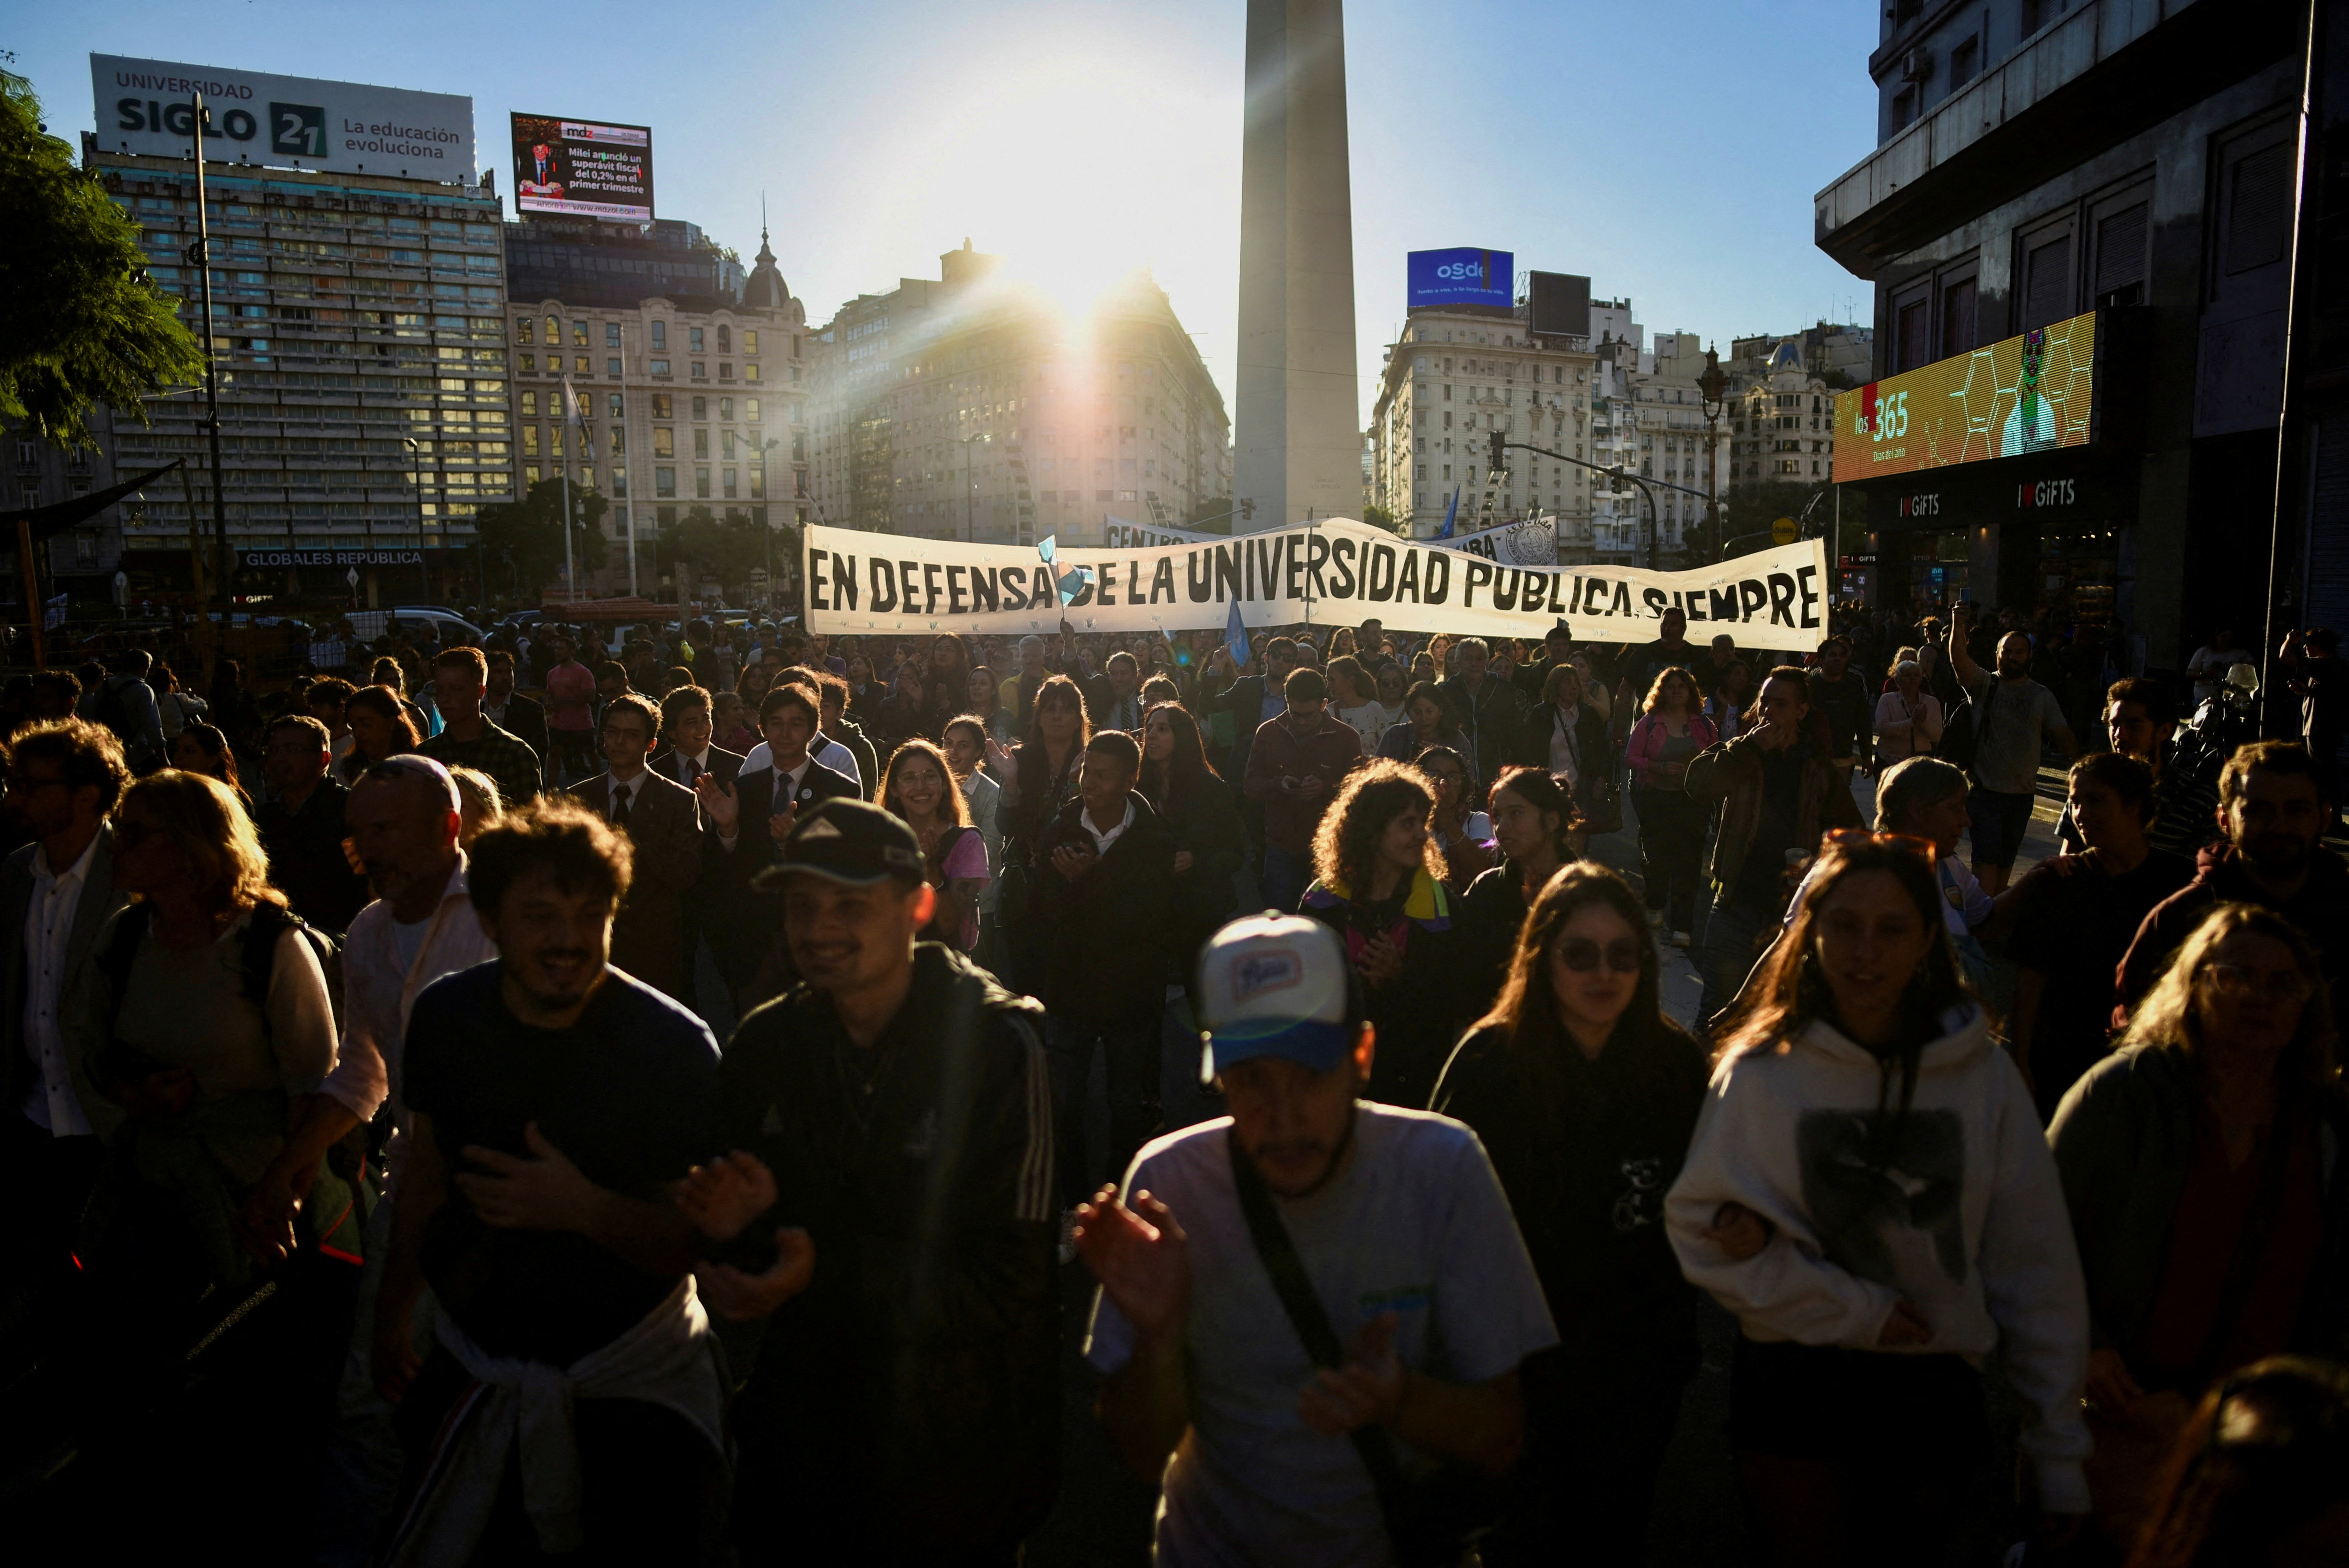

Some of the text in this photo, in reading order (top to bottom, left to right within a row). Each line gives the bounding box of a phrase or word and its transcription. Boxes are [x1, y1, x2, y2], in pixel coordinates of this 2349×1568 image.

[116, 72, 253, 100] UNIVERSIDAD
[117, 98, 319, 155] SIGLO 21
[344, 118, 460, 144] La educación
[567, 126, 593, 138] mdz
[345, 137, 444, 159] evoluciona
[569, 147, 591, 158] Milei
[592, 150, 628, 162] anunció
[572, 159, 640, 173] superávit fiscal
[576, 169, 590, 178] del
[591, 172, 614, 181] 0,2%
[629, 173, 637, 183] el
[569, 179, 644, 194] primer trimestre
[1855, 391, 1908, 442] los 365
[2018, 484, 2021, 508] I
[1900, 497, 1903, 517] I
[1508, 522, 1525, 534] CEU
[1534, 519, 1552, 531] UBA
[247, 550, 422, 566] GLOBALES REPÚBLICA
[809, 548, 858, 611] EN
[869, 557, 1054, 614] DEFENSA
[1128, 556, 1175, 605] LA
[1187, 534, 1450, 605] UNIVERSIDAD
[1464, 559, 1640, 620] PUBLICA,
[1642, 565, 1820, 629] SIEMPRE
